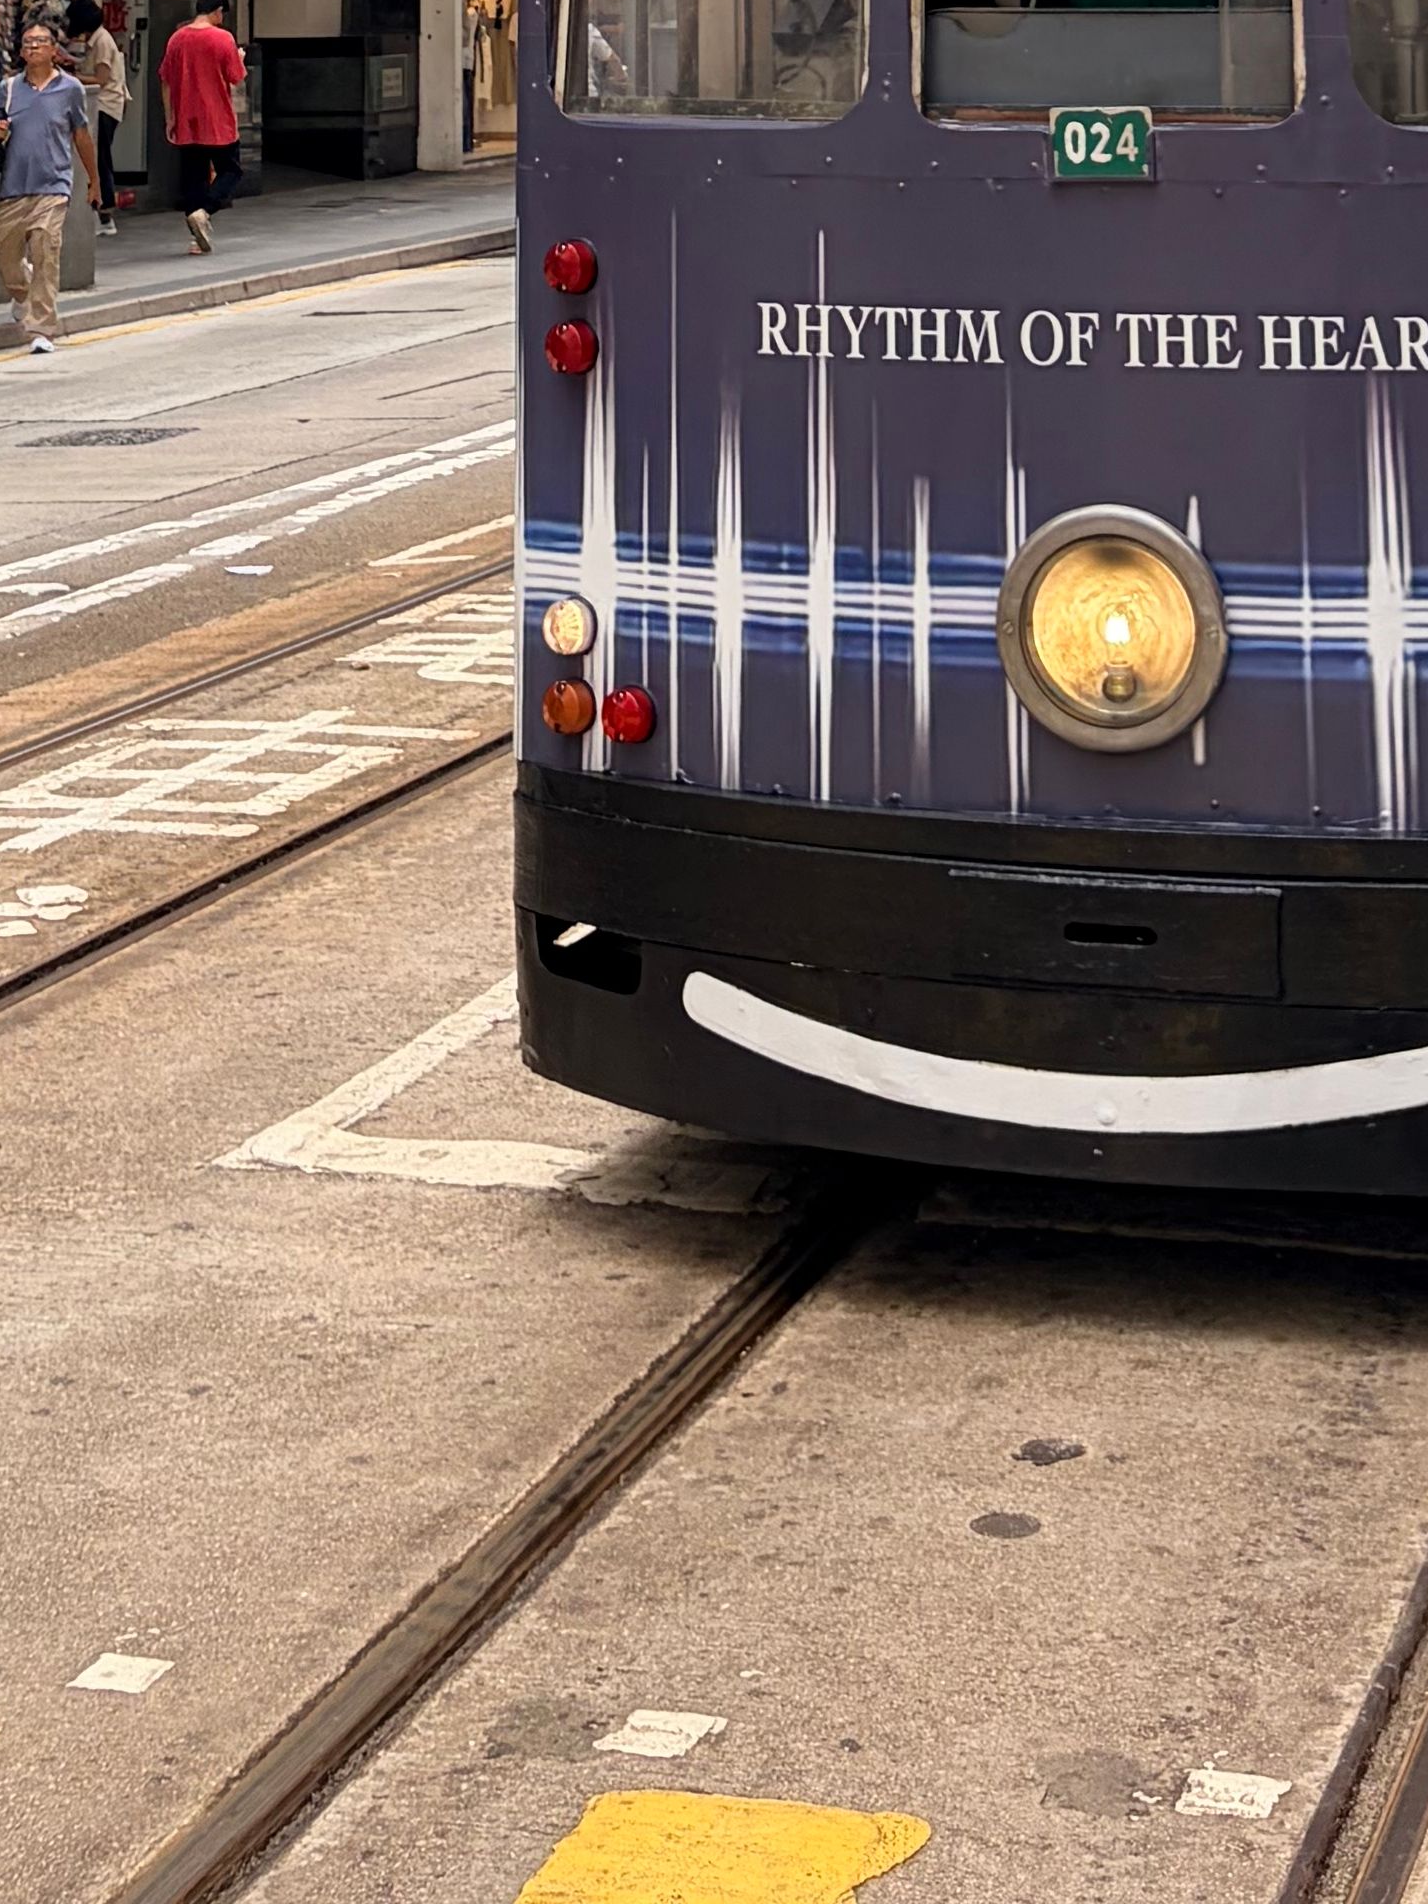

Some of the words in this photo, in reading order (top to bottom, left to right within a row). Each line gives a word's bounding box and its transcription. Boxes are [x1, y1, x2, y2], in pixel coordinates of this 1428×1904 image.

[1063, 121, 1140, 165] 024
[756, 300, 1006, 364] RHYTHM
[1019, 309, 1100, 368] OF
[1115, 312, 1243, 371] THE
